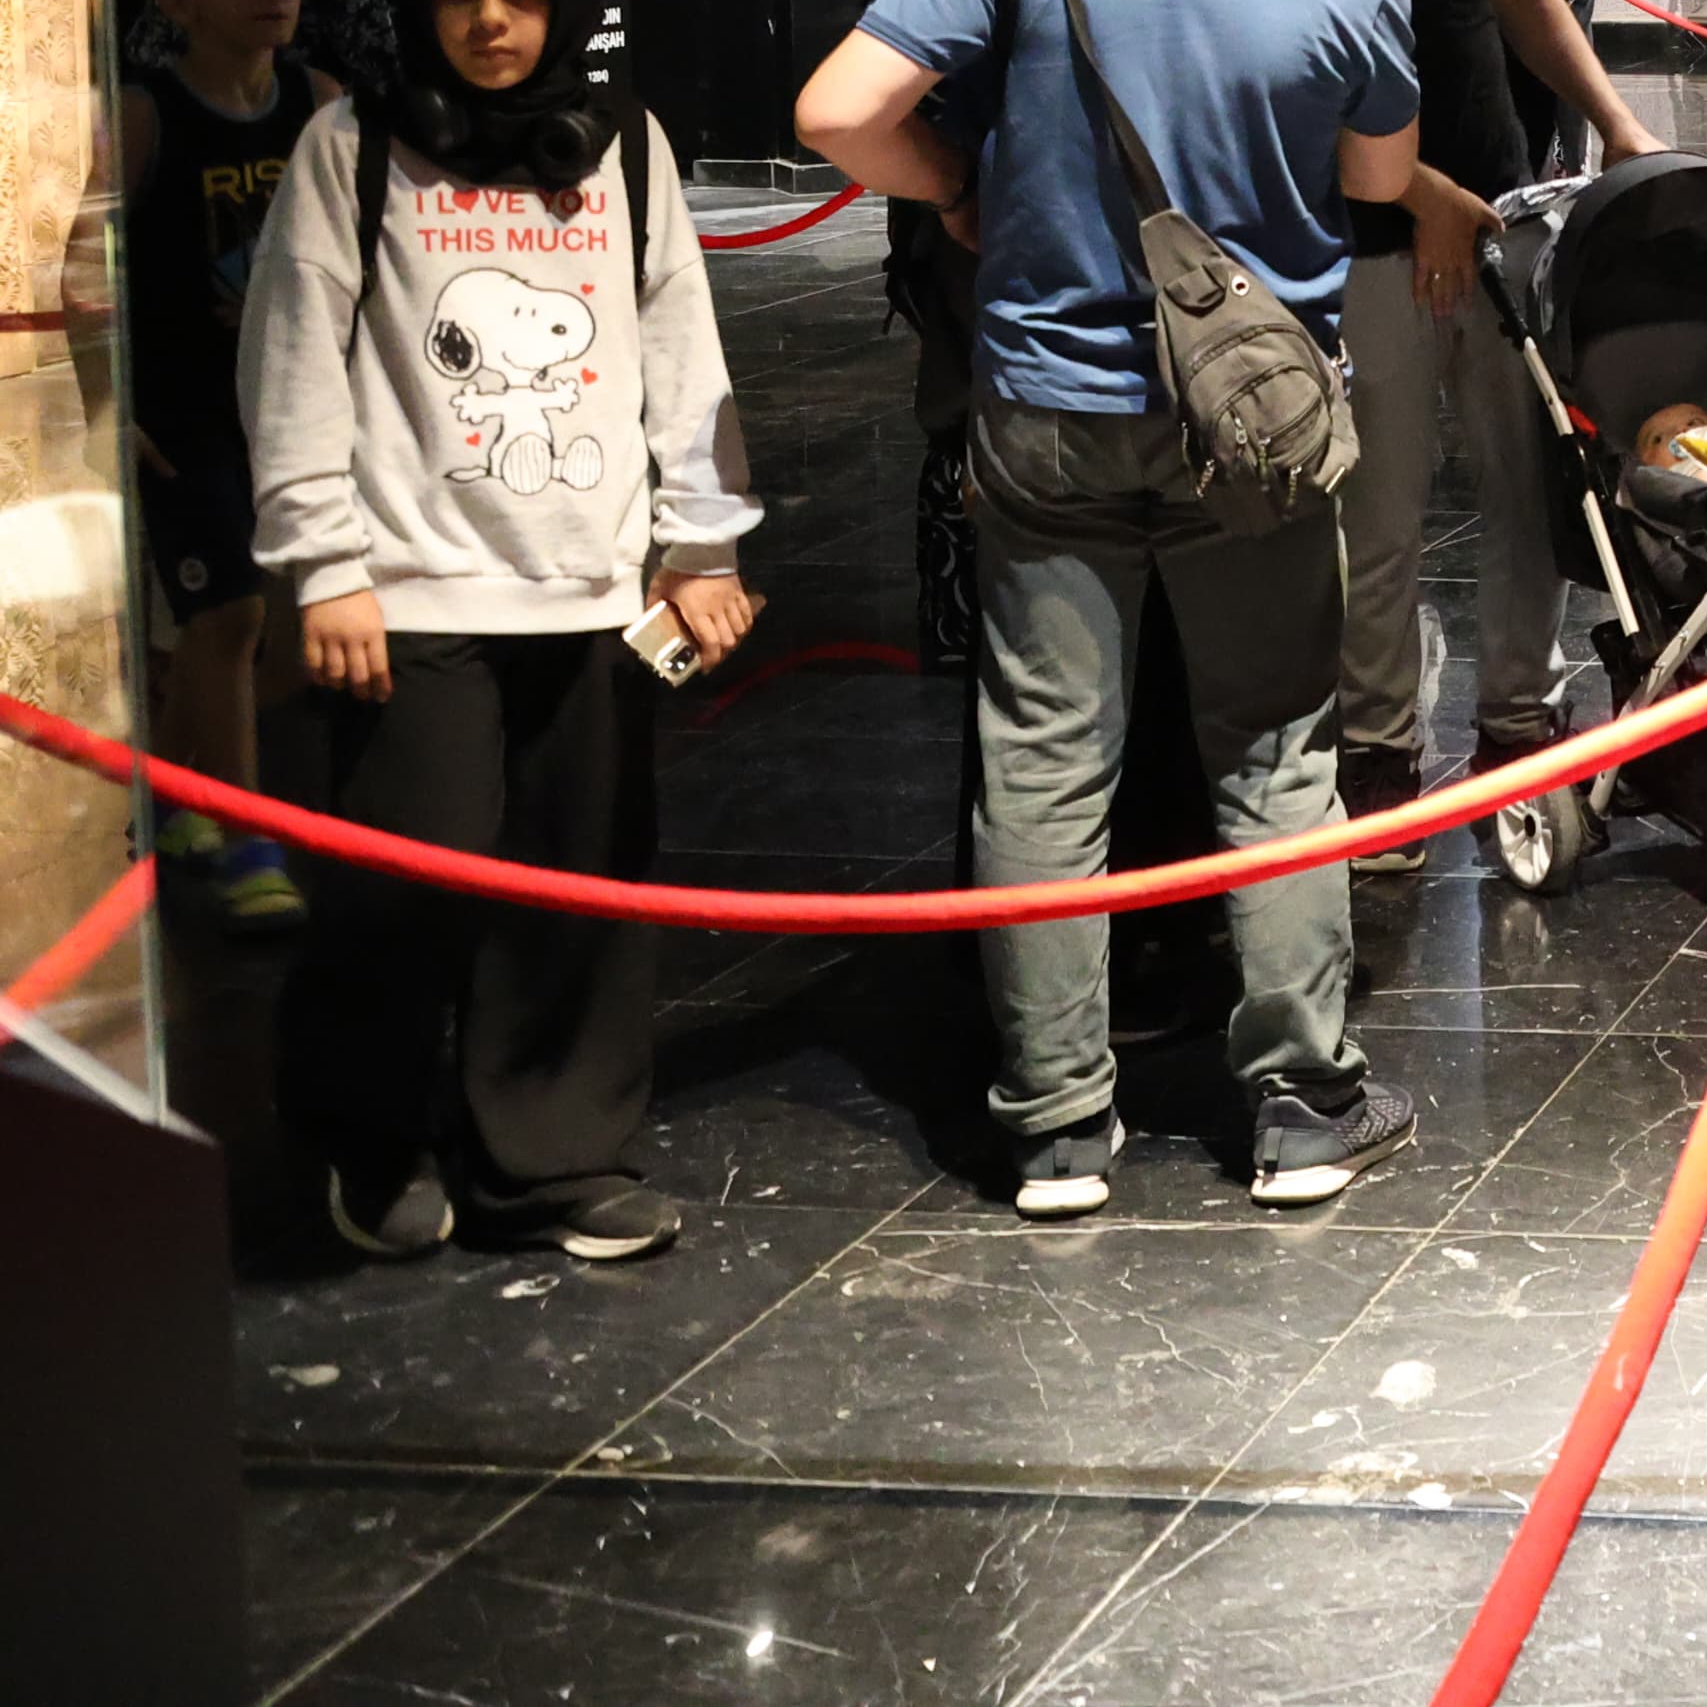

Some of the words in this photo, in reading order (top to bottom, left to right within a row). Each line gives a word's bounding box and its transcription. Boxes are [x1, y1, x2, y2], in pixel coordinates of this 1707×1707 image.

[415, 190, 424, 215] I
[416, 227, 496, 253] THIS
[507, 227, 608, 253] MUCH
